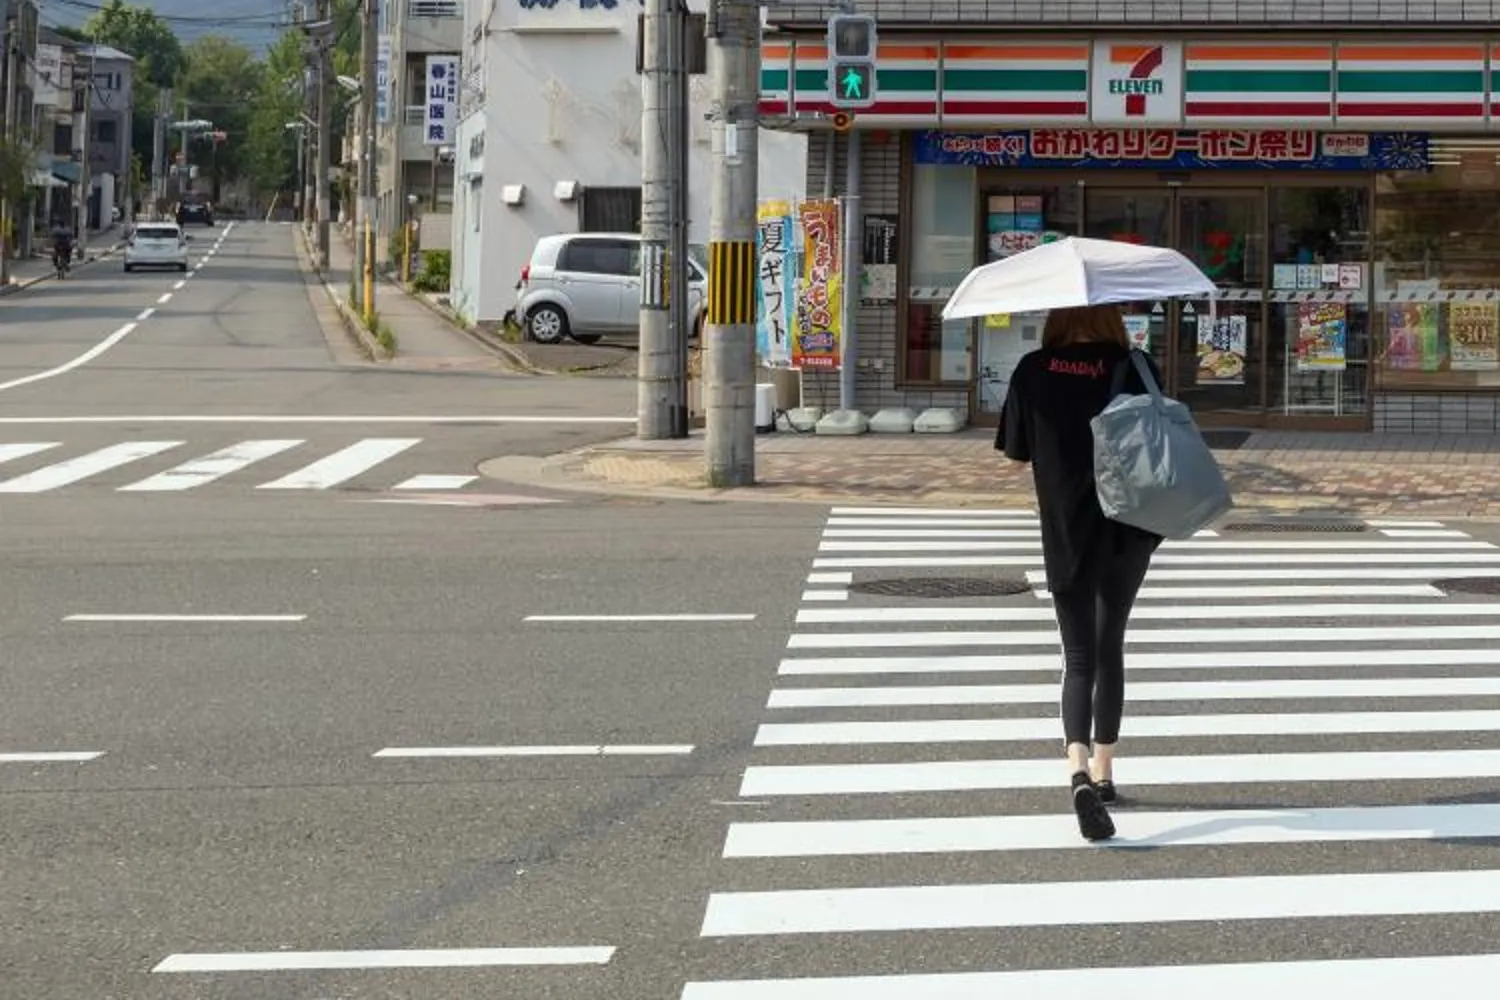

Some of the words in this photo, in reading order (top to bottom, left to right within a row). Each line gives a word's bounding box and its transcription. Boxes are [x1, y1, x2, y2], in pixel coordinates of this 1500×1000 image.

[1032, 129, 1315, 158] おかわりクーポン祭り
[759, 216, 789, 344] 夏ギフト
